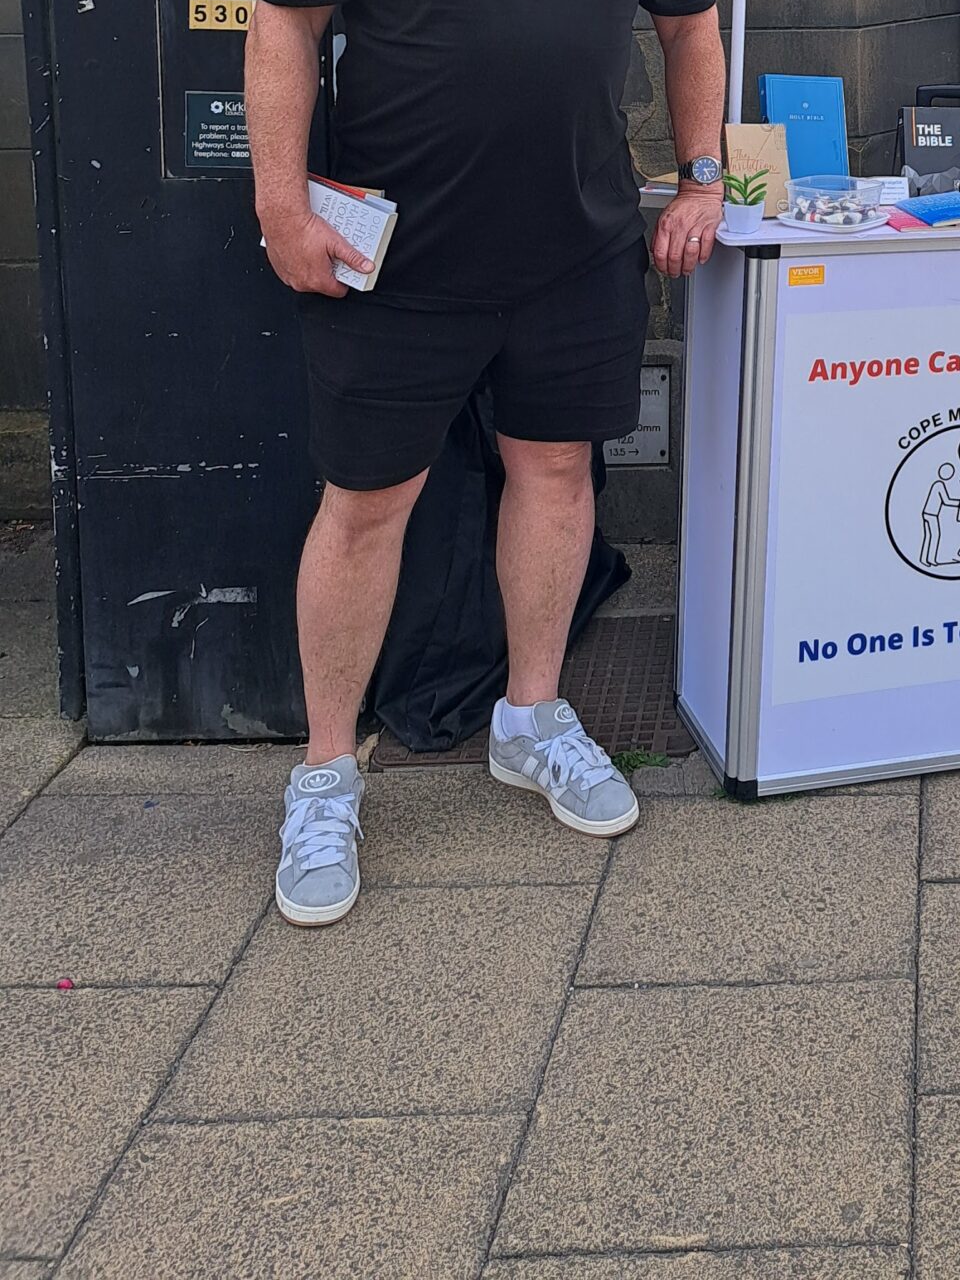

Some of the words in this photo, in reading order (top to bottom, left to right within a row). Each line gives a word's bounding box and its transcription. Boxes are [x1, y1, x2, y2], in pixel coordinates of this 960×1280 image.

[916, 124, 941, 135] THE
[230, 133, 249, 141] pleas
[918, 136, 953, 147] BIBLE
[192, 141, 224, 150] Highways
[808, 357, 920, 386] Anyone
[636, 424, 661, 432] 0mm
[898, 413, 943, 450] COPE
[799, 640, 838, 663] No
[847, 632, 904, 655] One
[912, 626, 935, 648] Is
